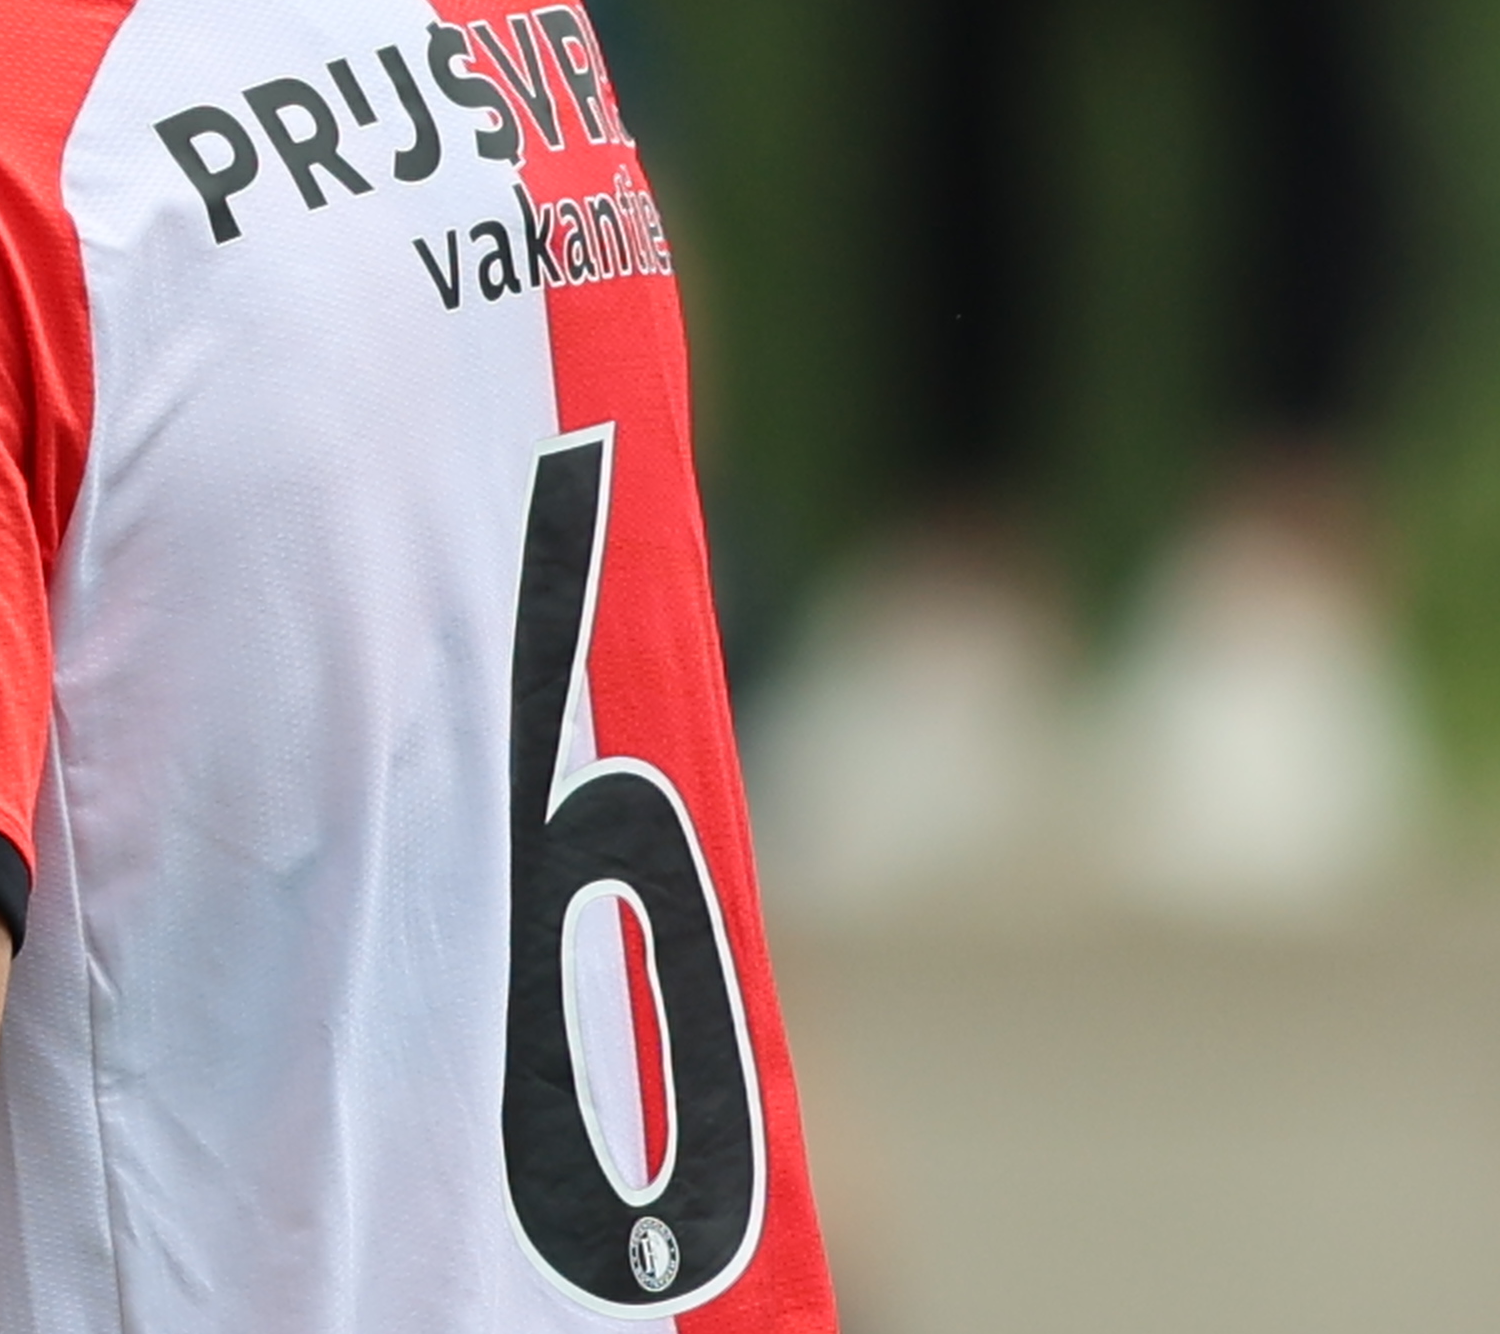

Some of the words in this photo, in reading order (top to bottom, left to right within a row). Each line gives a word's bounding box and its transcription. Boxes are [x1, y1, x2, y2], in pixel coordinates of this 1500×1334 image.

[153, 4, 635, 245] PRIJSVR
[412, 165, 671, 312] vakantie
[501, 420, 766, 1321] 6
